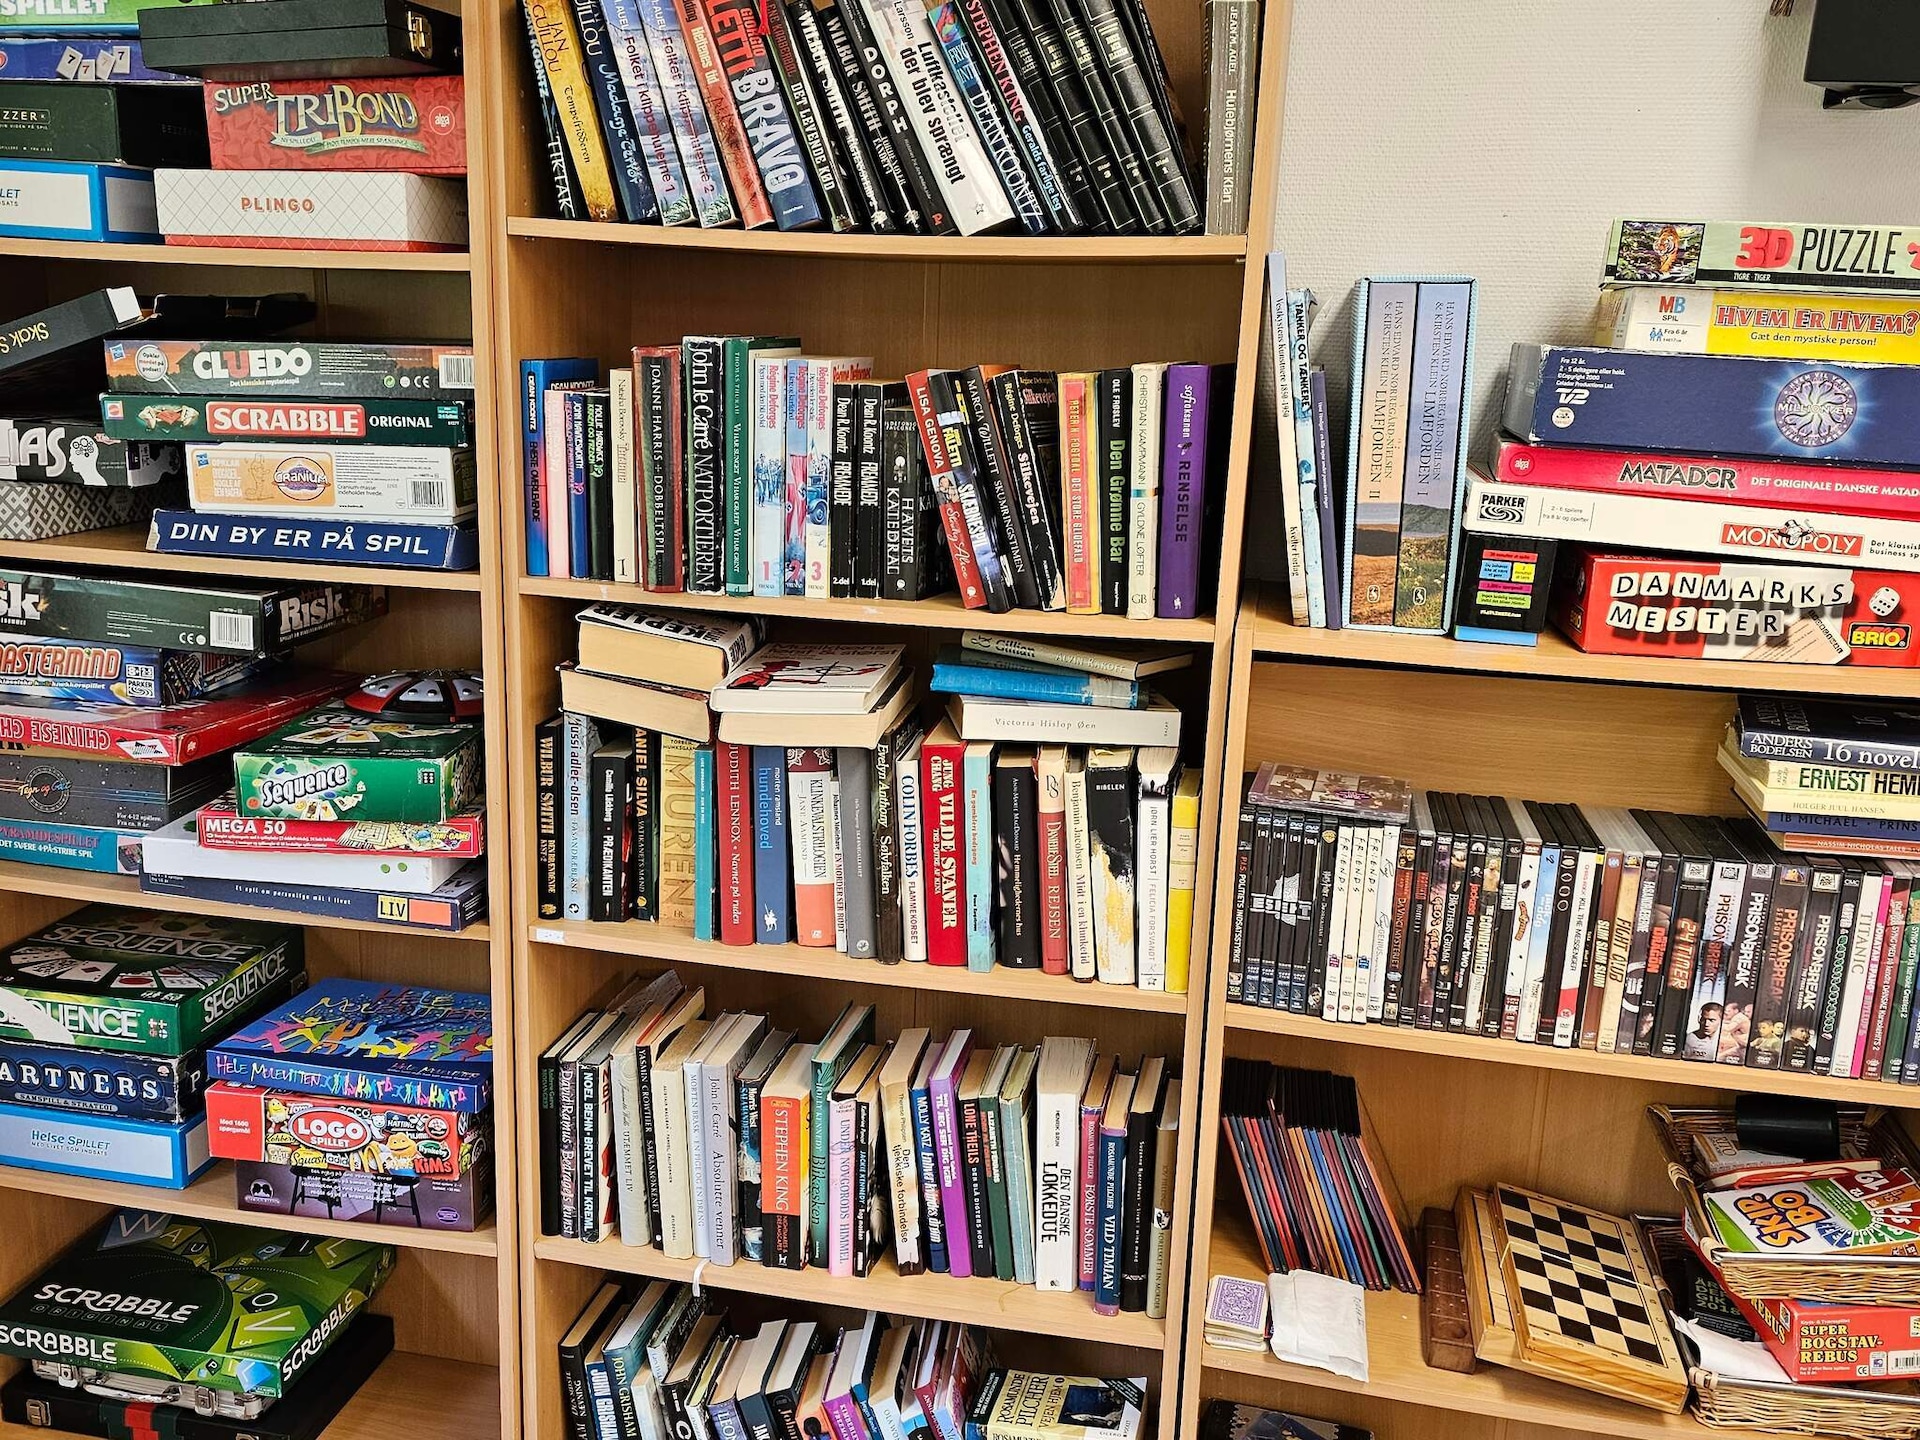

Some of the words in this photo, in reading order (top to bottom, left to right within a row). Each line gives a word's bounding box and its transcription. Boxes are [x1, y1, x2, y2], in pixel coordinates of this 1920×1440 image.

[532, 4, 561, 72] GUILLOU
[68, 55, 76, 64] 7
[119, 52, 124, 60] 7
[214, 83, 277, 112] SUPER
[732, 68, 806, 193] BRAVO
[900, 48, 920, 75] der
[911, 75, 936, 115] blev
[928, 116, 966, 185] sprængt
[1223, 89, 1238, 172] Hulebjørnens
[241, 198, 314, 213] PLINGO
[1224, 176, 1236, 202] Klan
[1734, 226, 1795, 269] 3D
[1800, 228, 1902, 274] PUZZLE
[1733, 272, 1750, 281] TIGRE
[1754, 273, 1770, 282] TIGER
[1295, 302, 1306, 341] TANKER
[1394, 301, 1404, 330] HANS
[1444, 301, 1455, 330] HANS
[1658, 296, 1686, 314] MB
[1662, 314, 1678, 322] SPIL
[1715, 304, 1788, 328] HVEM
[1793, 309, 1824, 329] ER
[1382, 312, 1392, 356] KIRSTEN
[1391, 331, 1401, 370] EDVARD
[1432, 313, 1442, 356] KIRSTEN
[1750, 331, 1769, 341] Gæt
[1773, 333, 1789, 342] den
[1793, 333, 1837, 345] mystiske
[1840, 335, 1876, 346] person!
[193, 348, 312, 380] CLUEDO
[1277, 343, 1287, 382] Kunstnere
[1298, 344, 1307, 360] OG
[1442, 332, 1452, 372] EDVARD
[651, 364, 661, 413] JOANNE
[1299, 362, 1310, 408] TÆNKERE
[1380, 357, 1390, 387] KLEIN
[1429, 358, 1440, 388] KLEIN
[767, 393, 778, 429] Deforges
[817, 395, 828, 430] Deforges
[1138, 375, 1147, 426] CHRISTIAN
[212, 407, 360, 434] SCRABBLE
[369, 416, 433, 428] ORIGINAL
[652, 416, 663, 459] HARRIS
[916, 387, 928, 416] LISA
[924, 418, 944, 469] GENOVA
[1370, 389, 1387, 483] LIMFJORDEN
[1418, 391, 1437, 484] LIMFJORDEN
[1110, 439, 1125, 470] Den
[1137, 427, 1147, 485] KAMPMANN
[1617, 460, 1738, 491] MATADOR
[1751, 476, 1772, 488] DET
[1774, 477, 1832, 491] ORIGINALE
[1834, 481, 1879, 495] DANSKE
[653, 475, 665, 556] DOBBELTSPIL
[1109, 475, 1125, 532] Grønne
[1175, 461, 1191, 543] RENSELSE
[1482, 494, 1526, 508] PARKER
[171, 522, 218, 542] DIN
[229, 525, 264, 546] BY
[274, 529, 310, 549] ER
[322, 526, 354, 550] PÅ
[366, 532, 429, 555] SPIL
[694, 452, 716, 592] NATPORTIEREN
[902, 497, 914, 564] HAVETS
[1725, 525, 1860, 553] MONOPOLY
[1109, 536, 1125, 564] Bar
[1869, 547, 1908, 559] business
[1871, 539, 1888, 550] Det
[762, 561, 770, 581] 1
[812, 561, 822, 581] 3
[1851, 629, 1900, 648] BRIO
[128, 680, 153, 688] PARKER
[32, 722, 110, 749] CHINESE
[994, 717, 1035, 727] Victoria
[1040, 718, 1072, 731] Hislop
[1077, 720, 1097, 730] Øen
[1750, 734, 1814, 749] ANDERS
[1750, 744, 1813, 758] BODELSEN
[1823, 742, 1852, 761] 16
[262, 765, 347, 807] Sequence
[635, 776, 648, 817] SILVA
[1096, 783, 1125, 791] BIBELEN
[1799, 767, 1871, 792] ERNEST
[759, 767, 773, 849] hundehoved
[901, 775, 915, 821] COLIN
[1829, 804, 1849, 812] JUUL
[205, 819, 257, 835] MEGA
[263, 820, 286, 834] 50
[664, 754, 695, 911] MUREN
[1798, 815, 1858, 827] MICHAEL
[1879, 821, 1917, 832] PRINS
[904, 824, 918, 878] FORBES
[1073, 827, 1084, 869] Jacobsen
[379, 902, 406, 918] LIV
[908, 881, 918, 944] FLAMMEKORSET
[1048, 885, 1061, 939] REJSEN
[1575, 914, 1584, 927] THE
[1577, 897, 1586, 913] KILL
[42, 927, 255, 962] SEQUENCE
[1232, 909, 1243, 963] INDSATSSTYRKE
[1462, 916, 1475, 950] number
[1474, 916, 1492, 977] CONDEMNED
[1570, 928, 1581, 971] MESSENGER
[1616, 918, 1631, 952] FIGHT
[1647, 927, 1664, 973] DRAGON
[1851, 911, 1874, 976] TITANIC
[1461, 951, 1471, 967] two
[203, 946, 287, 1022] SEQUENCE
[638, 1049, 649, 1082] YASMIN
[583, 1072, 594, 1101] NOEL
[219, 1118, 231, 1126] Med
[583, 1103, 594, 1132] BEHN
[640, 1085, 652, 1133] CROWTHER
[963, 1103, 976, 1129] LONE
[32, 1130, 64, 1144] Helse
[68, 1135, 110, 1149] SPILLET
[298, 1118, 364, 1137] LOGO
[310, 1136, 350, 1148] SPILLET
[775, 1109, 789, 1171] STEPHEN
[840, 1119, 851, 1154] UNDER
[921, 1127, 932, 1149] KATZ
[583, 1137, 594, 1177] BREVET
[622, 1130, 632, 1175] UTÆMMET
[902, 1149, 911, 1168] Den
[965, 1130, 979, 1164] THEILS
[583, 1180, 594, 1194] TIL
[775, 1175, 789, 1211] KING
[840, 1157, 850, 1220] NOVGORODS
[1060, 1168, 1072, 1190] DEN
[583, 1197, 594, 1231] KREML
[898, 1189, 908, 1244] forbindelse
[1041, 1161, 1059, 1243] LOKKEDUE
[1059, 1194, 1072, 1237] DANSKE
[1085, 1184, 1096, 1225] FØRSTE
[714, 1211, 724, 1250] venner
[839, 1223, 849, 1264] HIMMEL
[1104, 1214, 1116, 1243] VILD
[1102, 1246, 1115, 1290] TIMIAN
[34, 1284, 199, 1324] SCRABBLE
[282, 1291, 355, 1382] SCRABBLE
[1800, 1324, 1848, 1336] SUPER
[1801, 1334, 1883, 1350] BOGSTAV-
[1800, 1350, 1859, 1364] REBUS
[620, 1387, 637, 1437] GRISHAM
